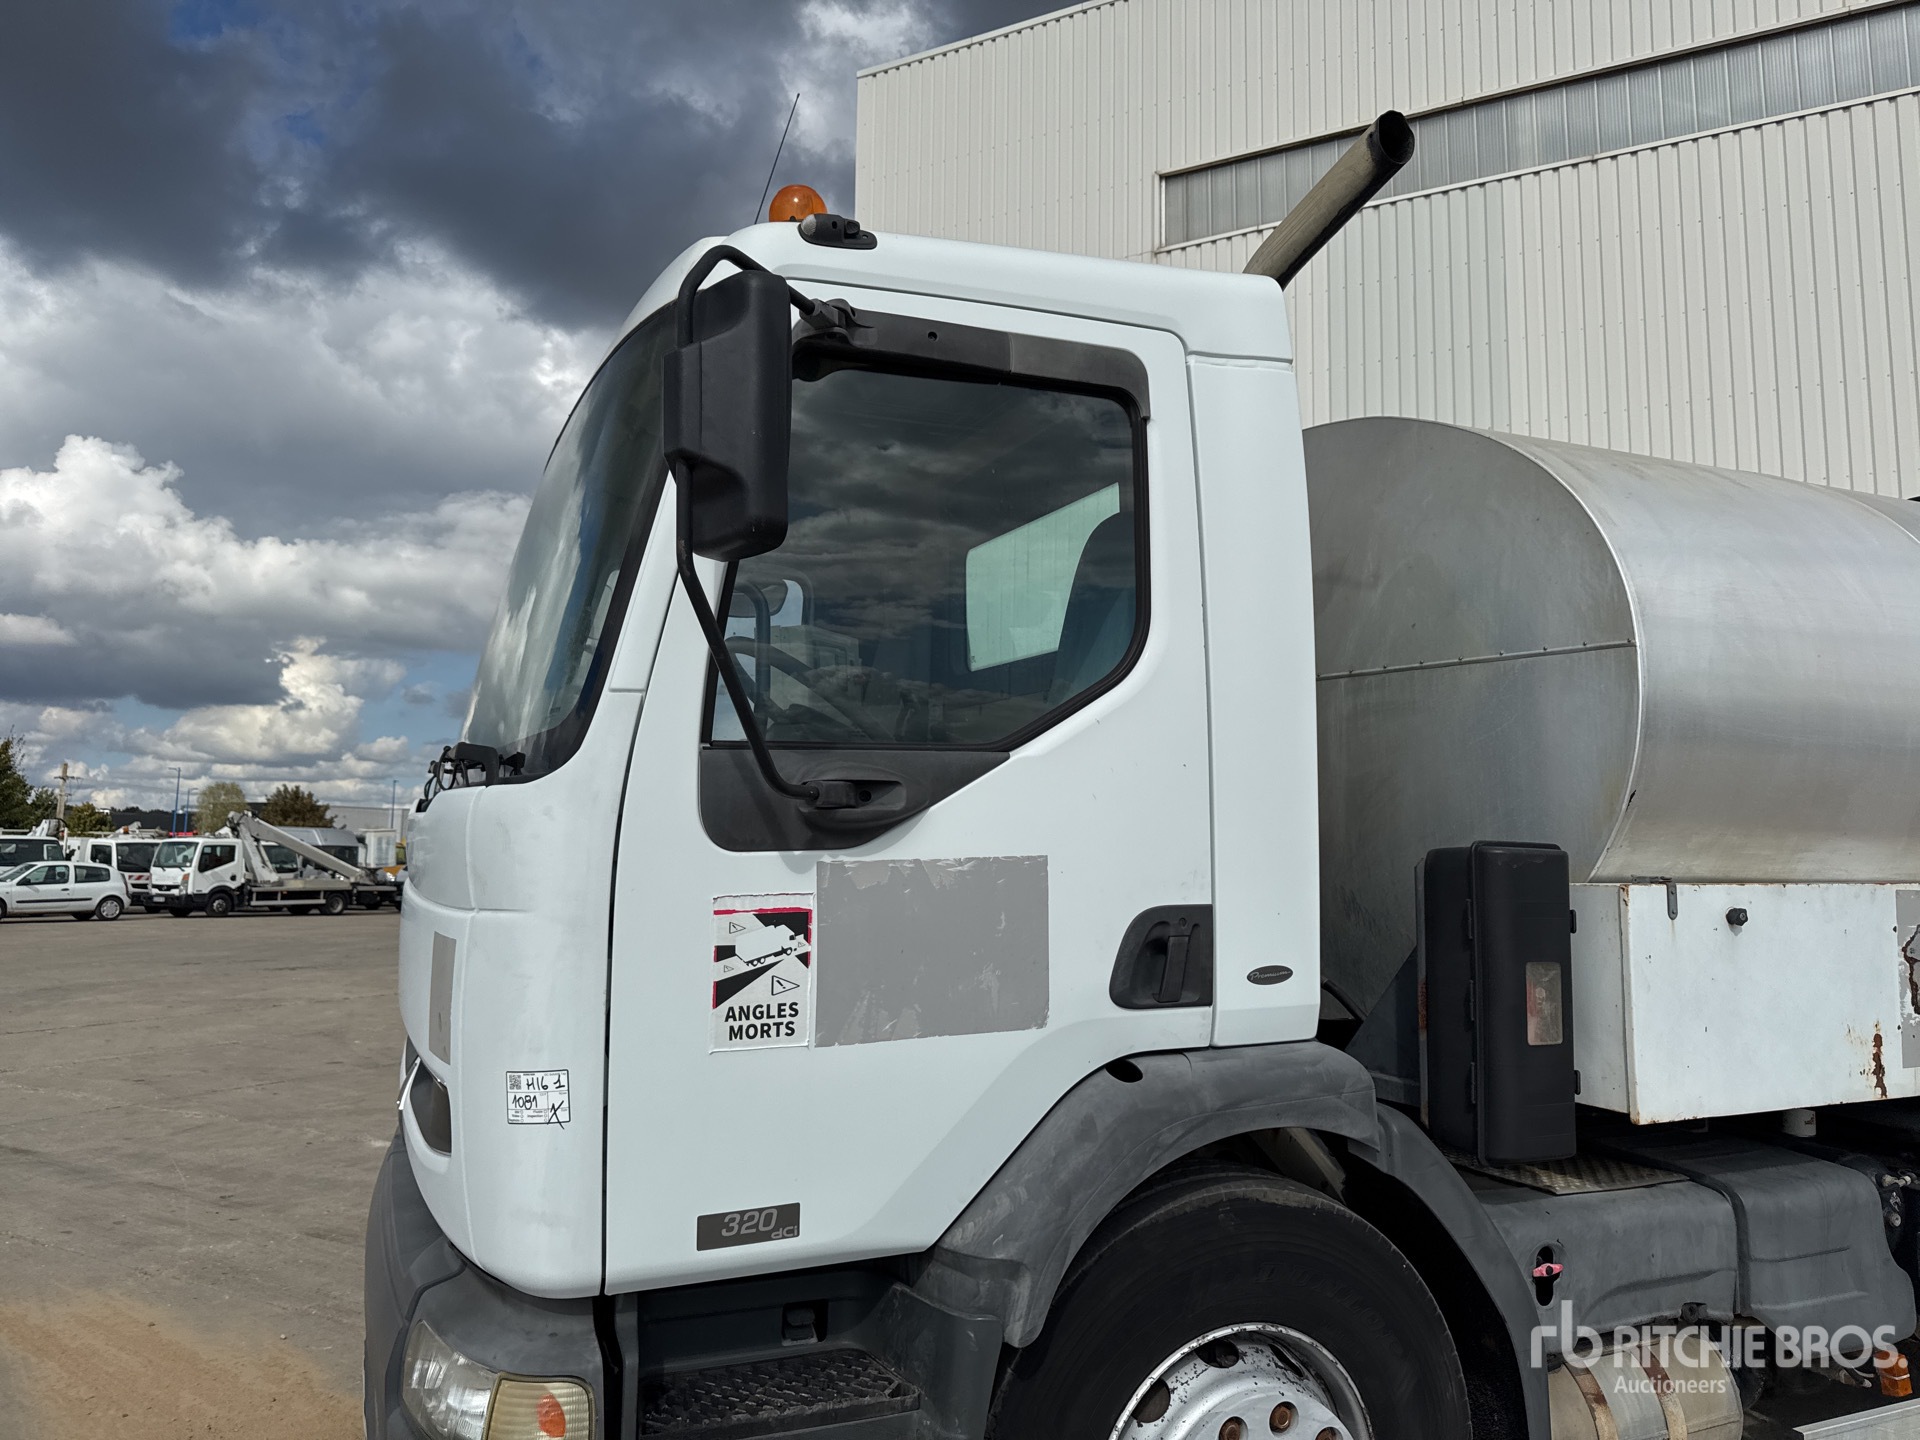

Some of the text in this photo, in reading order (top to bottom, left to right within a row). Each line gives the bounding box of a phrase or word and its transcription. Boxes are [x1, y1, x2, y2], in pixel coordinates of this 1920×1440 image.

[724, 1001, 799, 1022] ANGLES
[728, 1020, 796, 1041] MORTS
[511, 1094, 538, 1110] 1081
[721, 1208, 798, 1239] 320 dCi
[1253, 1262, 1405, 1357] DUNLOP
